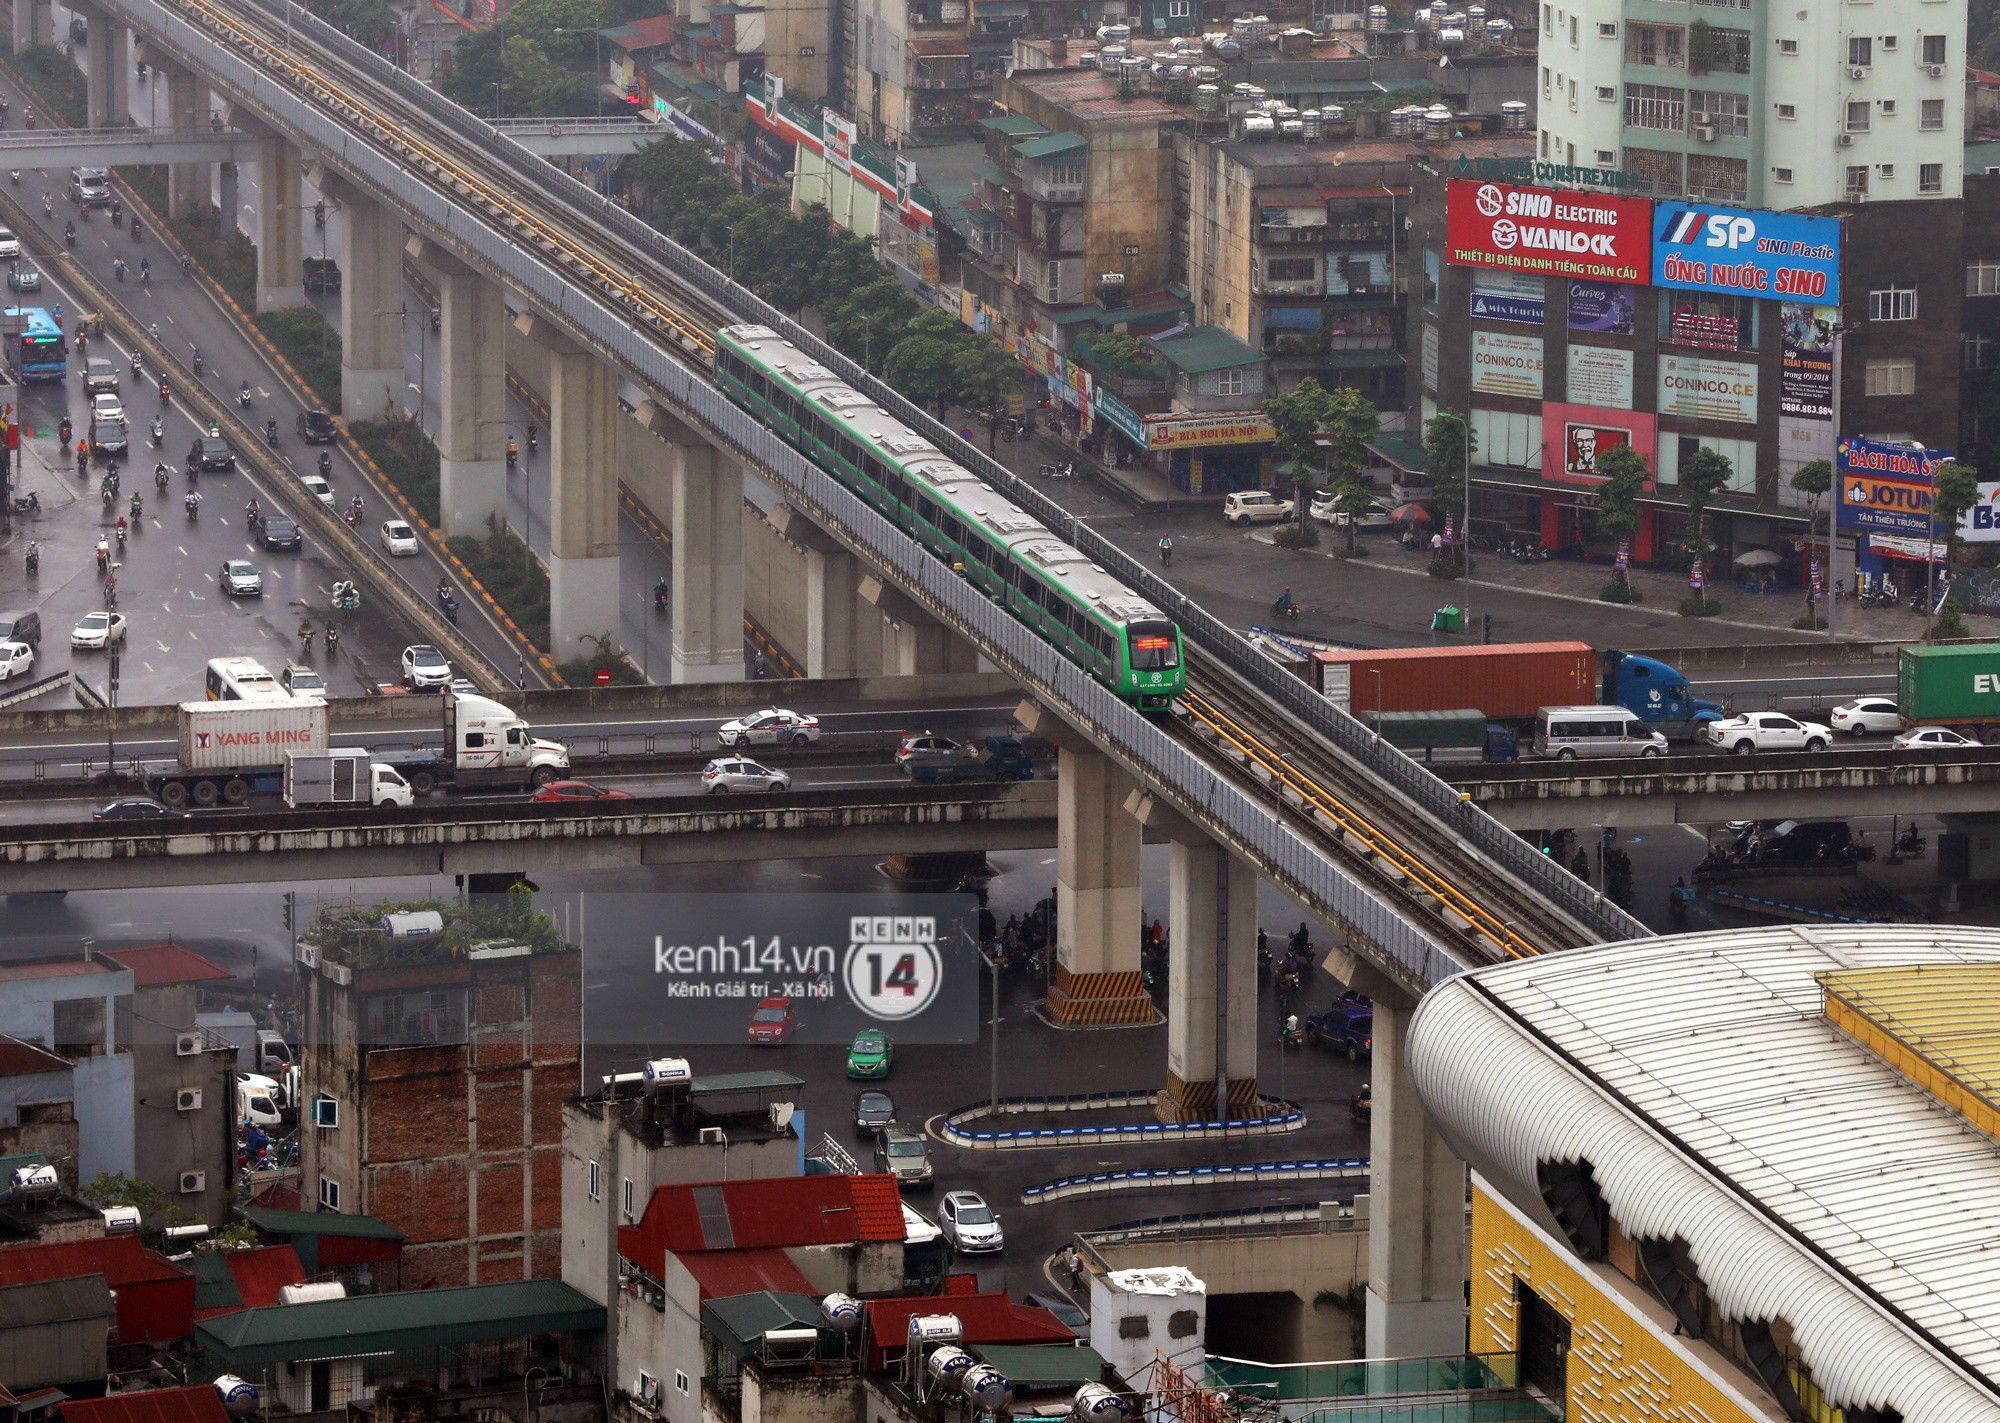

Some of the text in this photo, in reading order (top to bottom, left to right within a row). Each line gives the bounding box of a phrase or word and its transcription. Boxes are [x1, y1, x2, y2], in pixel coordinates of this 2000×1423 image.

[1537, 162, 1628, 189] CONSTREXIM
[1506, 192, 1618, 226] SINO ELECTRIC
[1520, 226, 1617, 257] VANLOCK
[1706, 214, 1756, 249] SP
[1757, 238, 1834, 260] SINO Plastic
[1455, 249, 1637, 280] THIẾT BỊ ĐIỆN DANH TIẾNG TOÀN CẦU
[1664, 252, 1827, 298] ỐNG NƯỚC SINO
[1570, 285, 1606, 300] Curves
[1489, 304, 1544, 318] Mix Tourist
[1783, 358, 1801, 367] KHAI
[1783, 370, 1802, 381] trong
[1180, 424, 1258, 440] BIA HƠI HÀ NỘI
[1849, 446, 1887, 470] BÁCH
[1890, 452, 1919, 475] HÓA
[1858, 512, 1873, 522] TÂN
[215, 729, 311, 746] YANG MING
